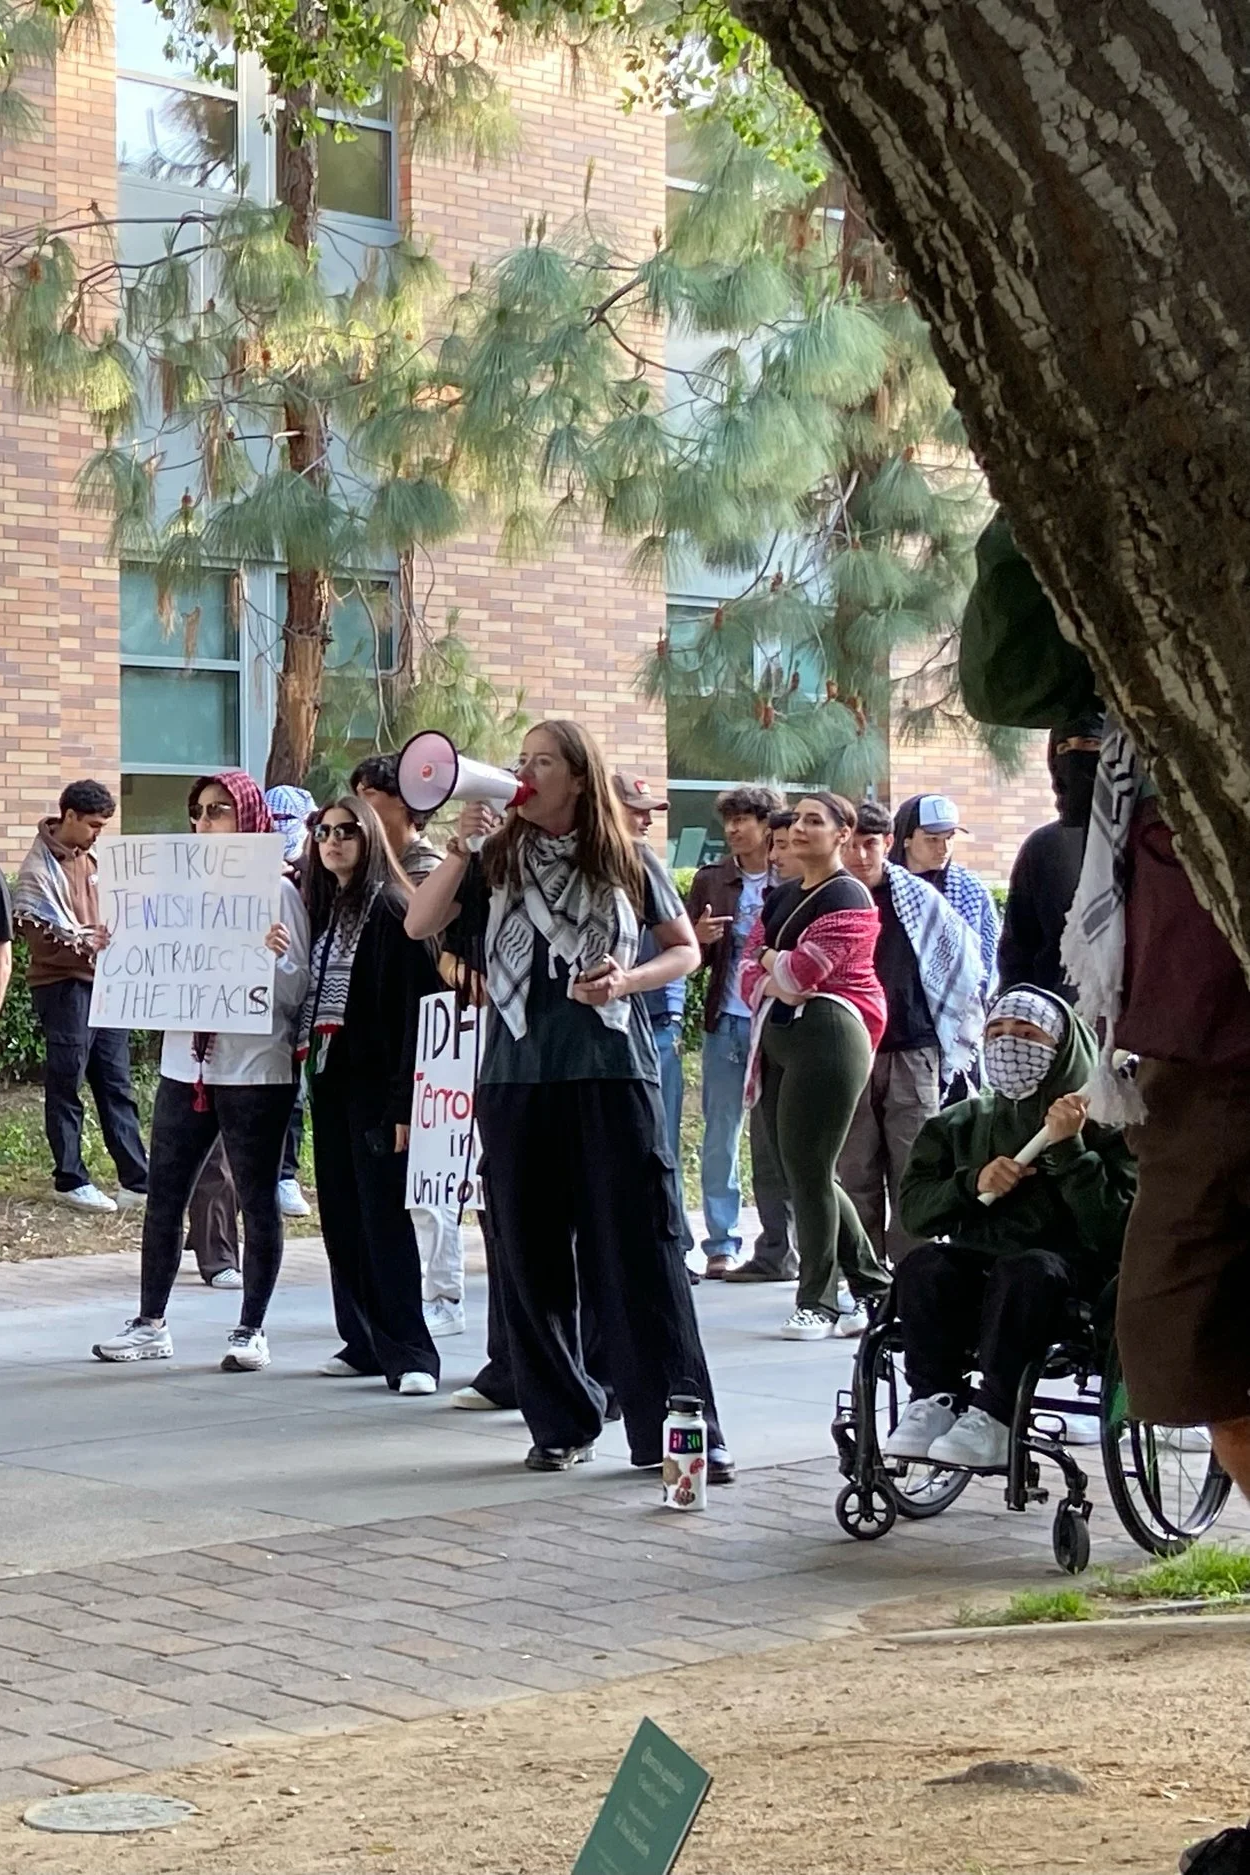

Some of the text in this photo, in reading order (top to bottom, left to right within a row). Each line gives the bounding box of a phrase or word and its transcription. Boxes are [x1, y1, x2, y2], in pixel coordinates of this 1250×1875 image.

[106, 842, 248, 882] THE TRUE
[106, 888, 273, 937] JEWISH FAITH
[102, 941, 271, 978] CONTRADICTS
[118, 981, 270, 1022] THE IDF ACTS
[423, 997, 476, 1061] IDF
[414, 1071, 471, 1129] Terro
[450, 1129, 477, 1159] in
